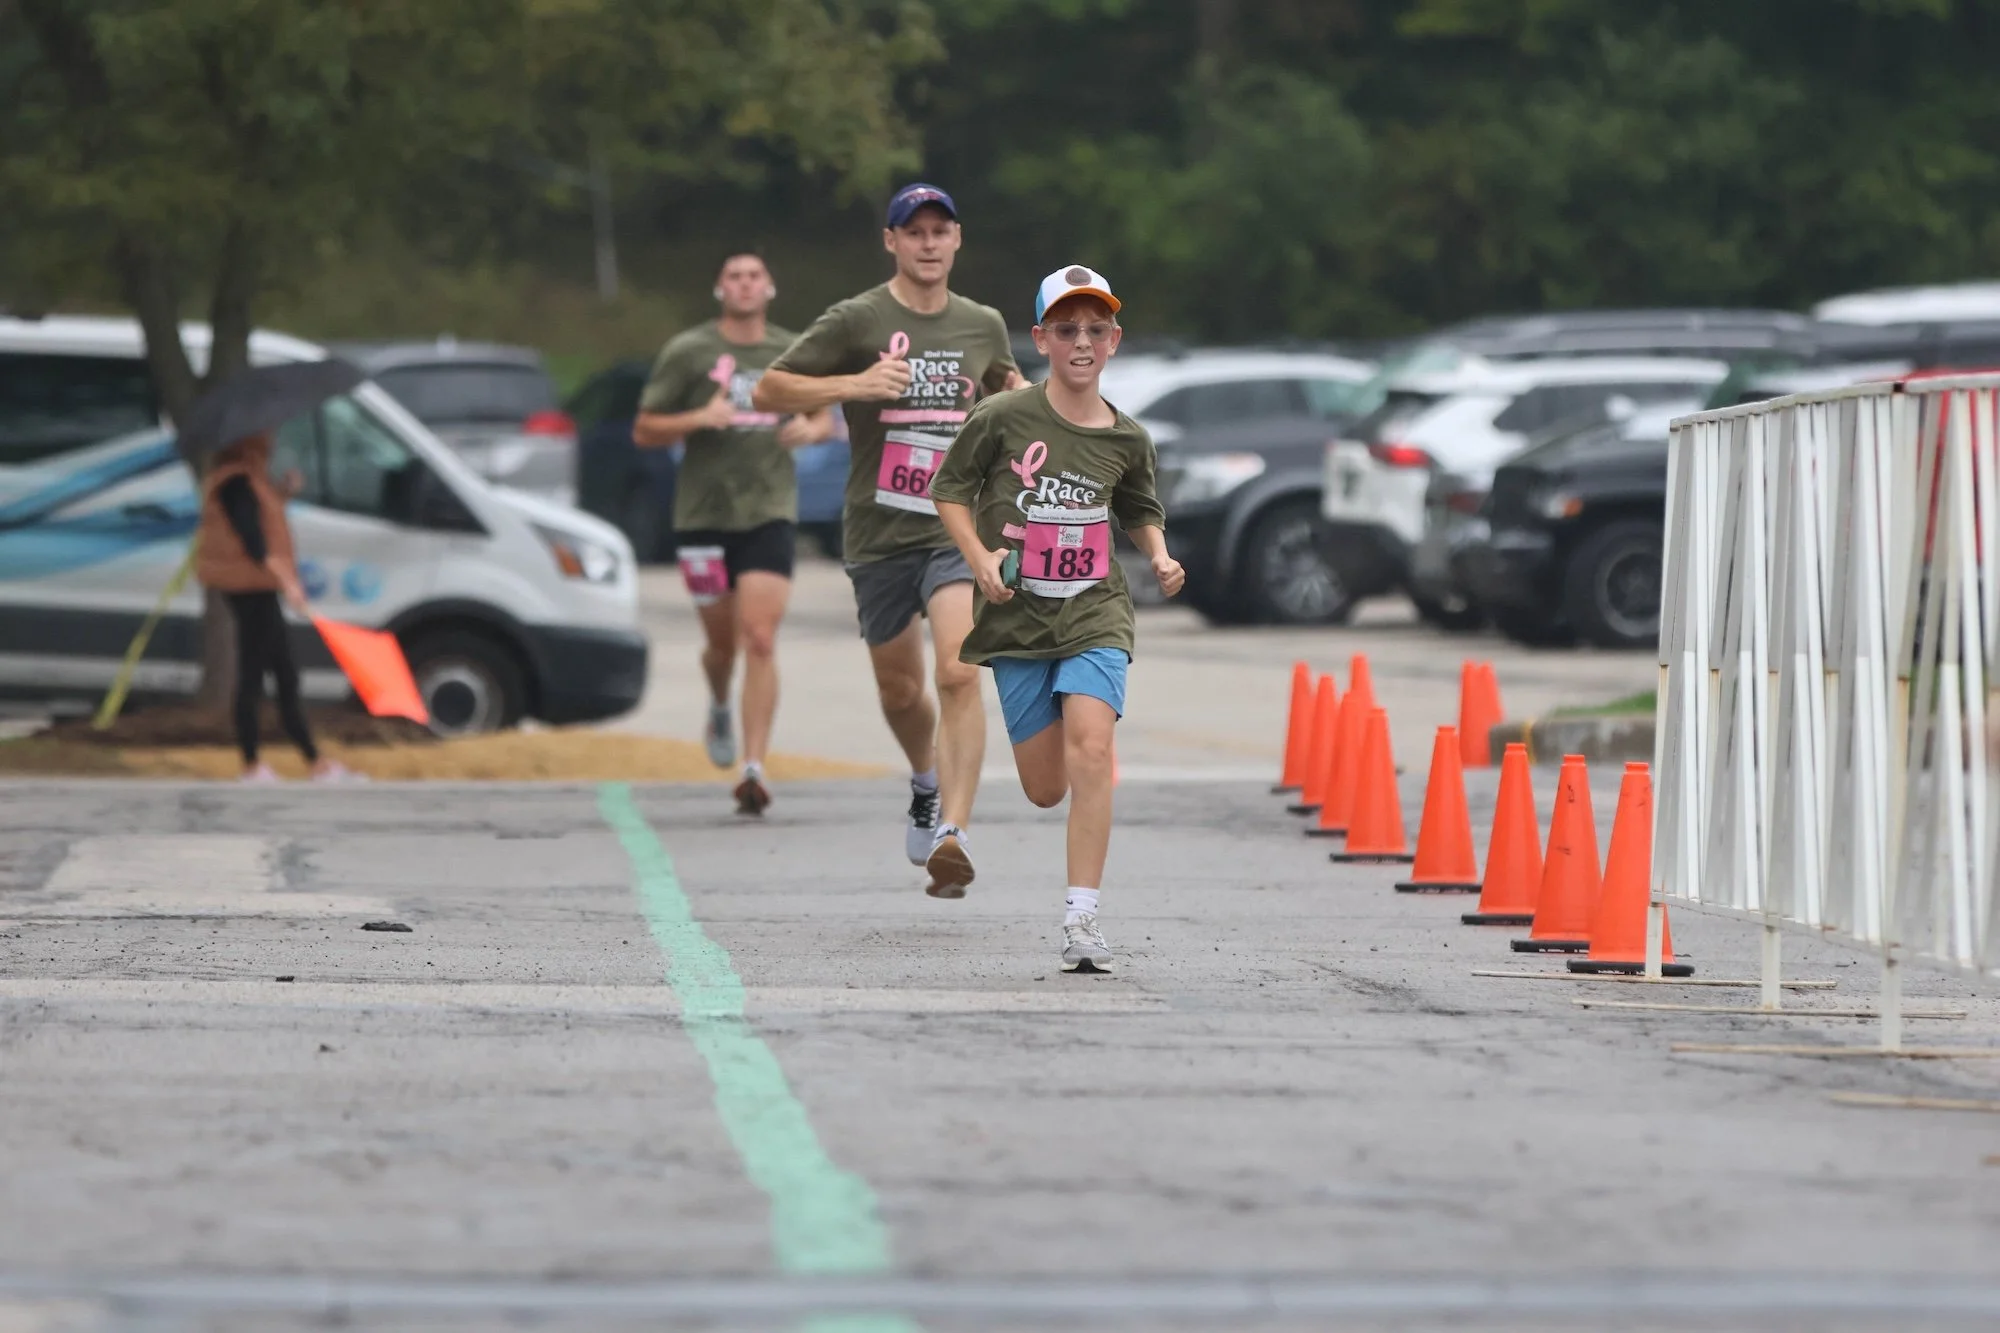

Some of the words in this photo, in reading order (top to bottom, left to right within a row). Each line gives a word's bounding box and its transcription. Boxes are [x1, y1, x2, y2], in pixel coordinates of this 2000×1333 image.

[908, 358, 960, 383] Race
[891, 465, 935, 494] 66
[1035, 475, 1096, 505] Race
[1060, 470, 1080, 482] 22nd
[1081, 476, 1106, 489] Annual
[1040, 547, 1096, 579] 183
